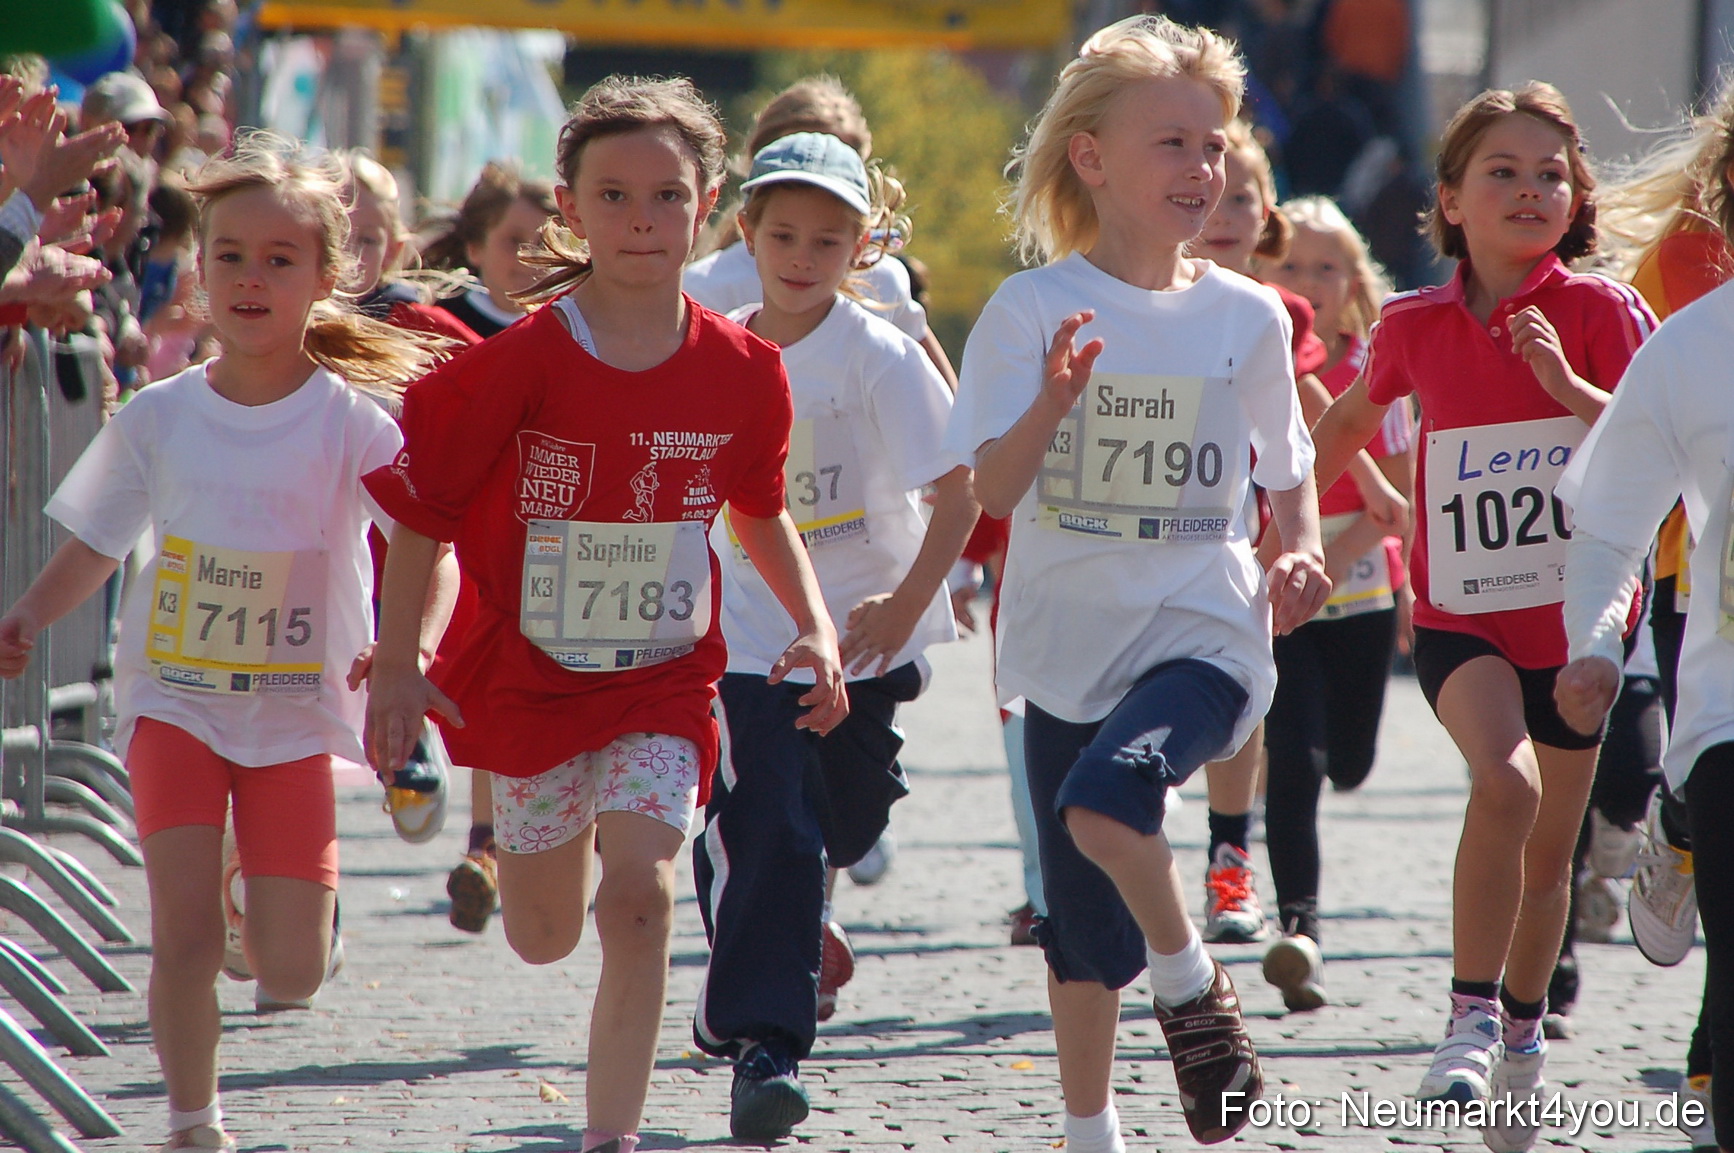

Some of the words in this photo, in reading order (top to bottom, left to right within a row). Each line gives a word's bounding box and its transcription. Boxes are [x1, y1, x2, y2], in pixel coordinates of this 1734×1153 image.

[1097, 385, 1175, 419] Sarah
[629, 432, 650, 446] 11.
[530, 445, 579, 469] IMMER
[1098, 438, 1223, 488] 7190
[1458, 440, 1572, 481] Lena
[526, 461, 581, 485] WIEDER
[520, 477, 576, 506] NEU
[784, 464, 842, 508] 37
[807, 518, 865, 541] PFLEIDERER
[1059, 513, 1108, 529] BOCK
[1162, 518, 1228, 532] PFLEIDERER
[577, 533, 657, 568] Sophie
[197, 555, 262, 590] Marie
[1480, 572, 1540, 588] PFLEIDERER
[531, 577, 554, 598] K3
[158, 591, 178, 614] K3
[578, 580, 694, 621] 7183
[197, 601, 312, 647] 7115
[547, 652, 589, 664] OCK
[252, 673, 320, 685] PFLEIDERER
